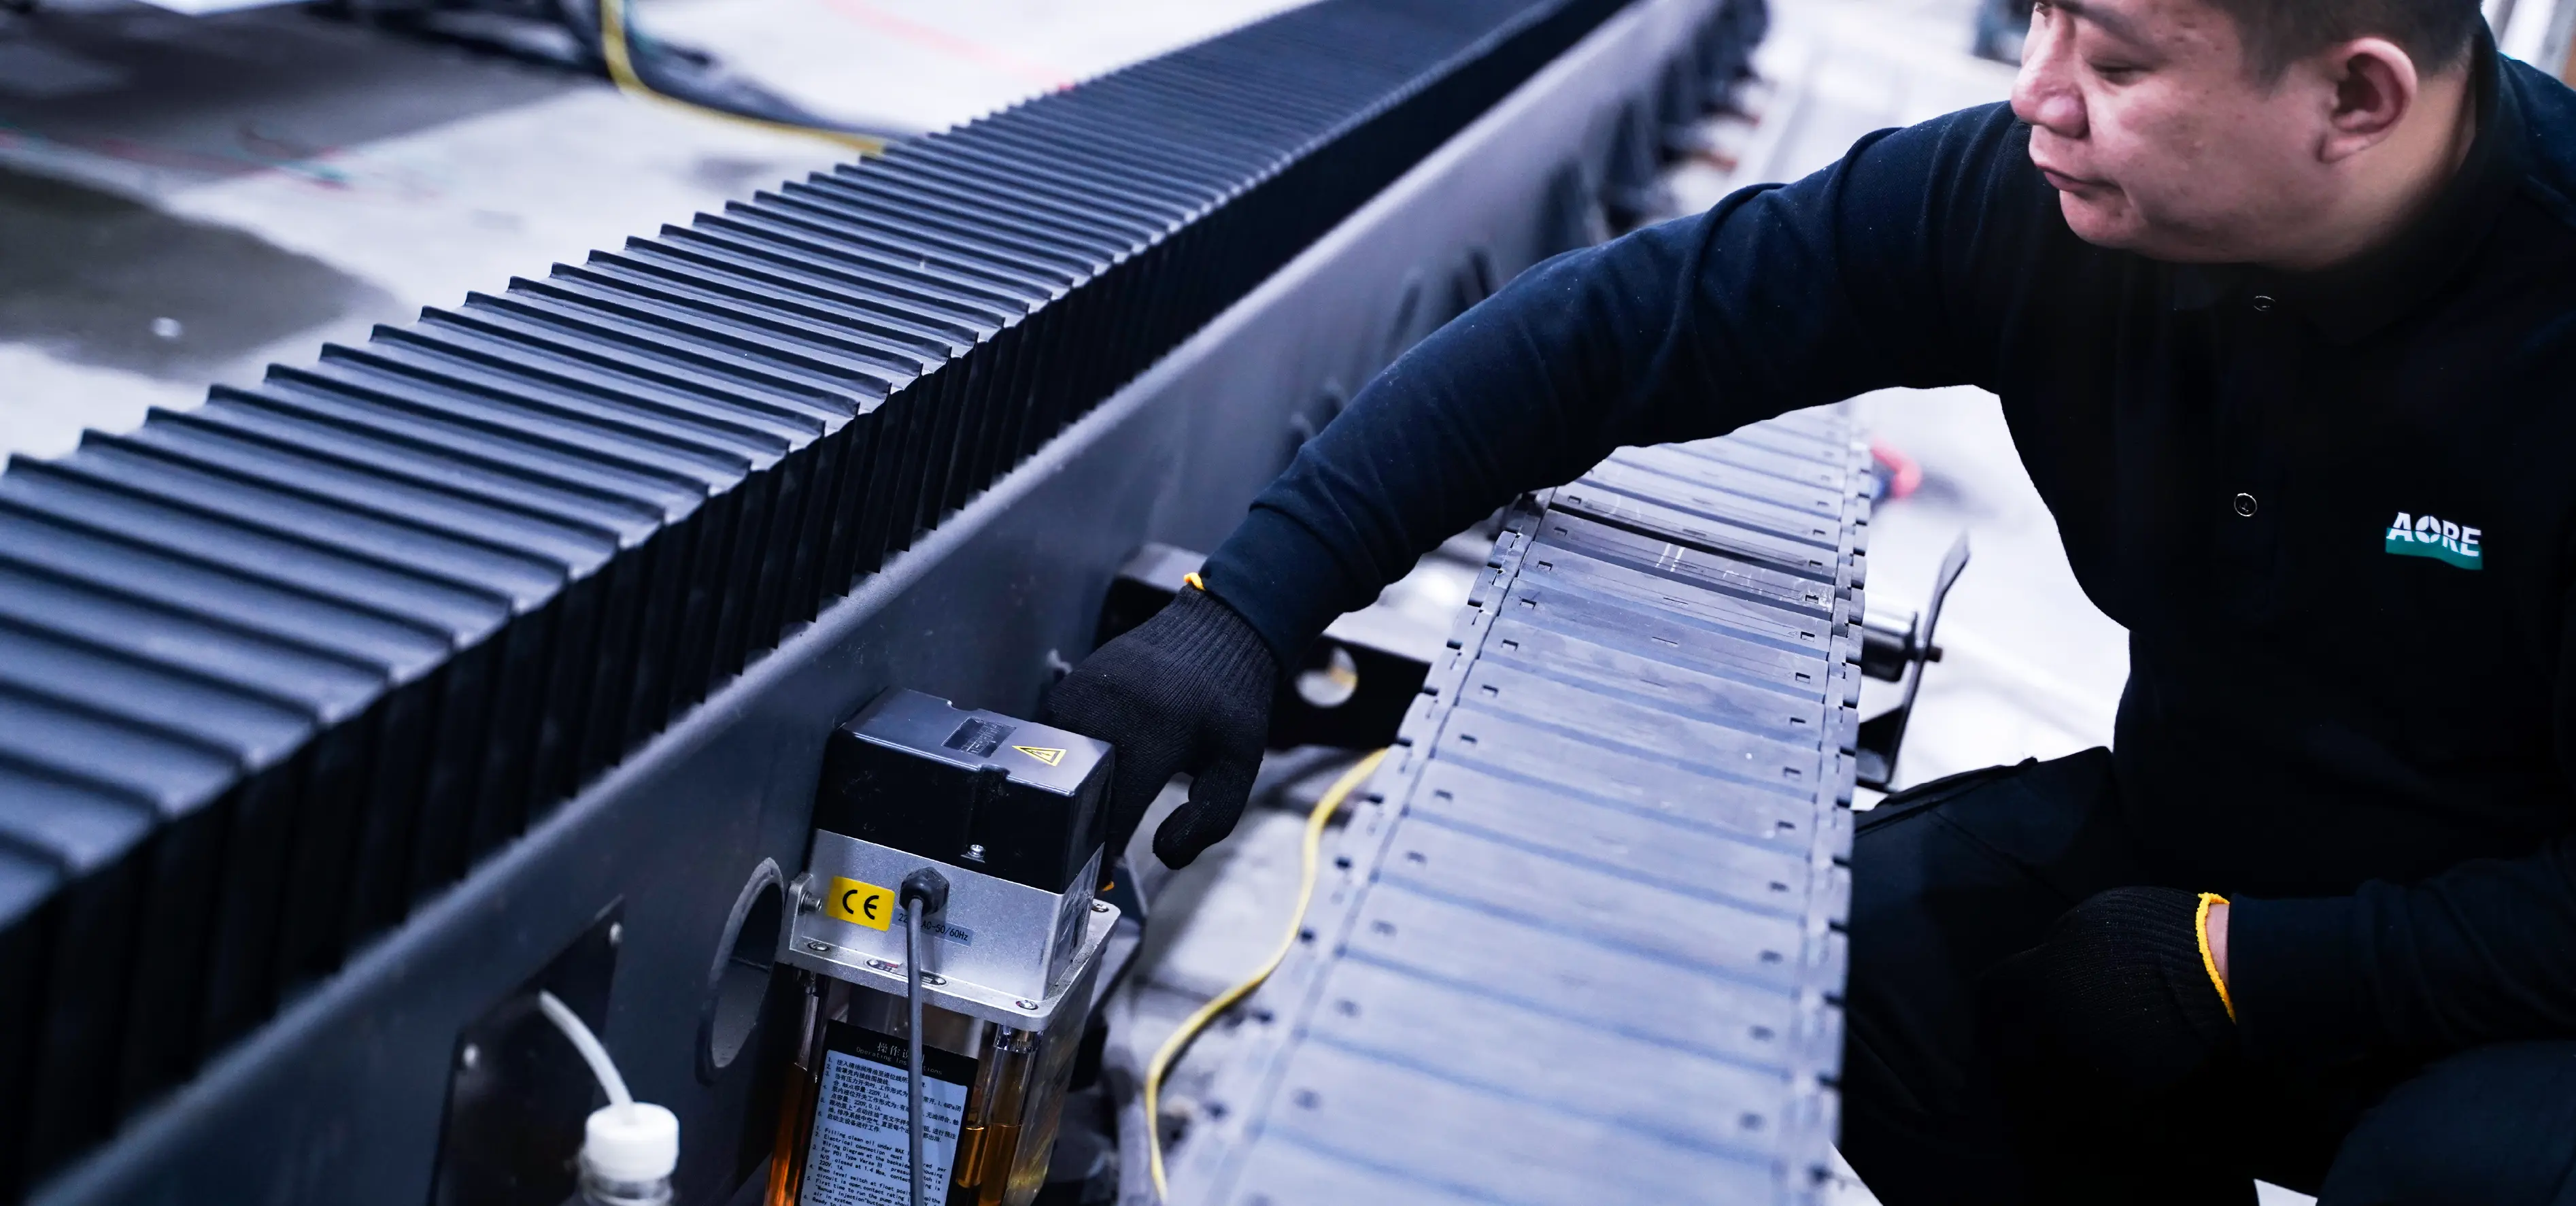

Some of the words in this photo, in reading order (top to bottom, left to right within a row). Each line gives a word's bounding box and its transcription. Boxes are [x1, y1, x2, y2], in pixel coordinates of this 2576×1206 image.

[2386, 512, 2481, 557] AORE
[842, 890, 879, 920] CE
[855, 1046, 892, 1061] Operating
[895, 1057, 943, 1075] Instions
[823, 1133, 853, 1146] Electrical
[824, 1127, 846, 1138] Filling
[847, 1134, 863, 1143] clean
[877, 1142, 892, 1151] under
[845, 1153, 857, 1161] Type
[815, 1178, 830, 1186] First
[832, 1170, 847, 1178] level
